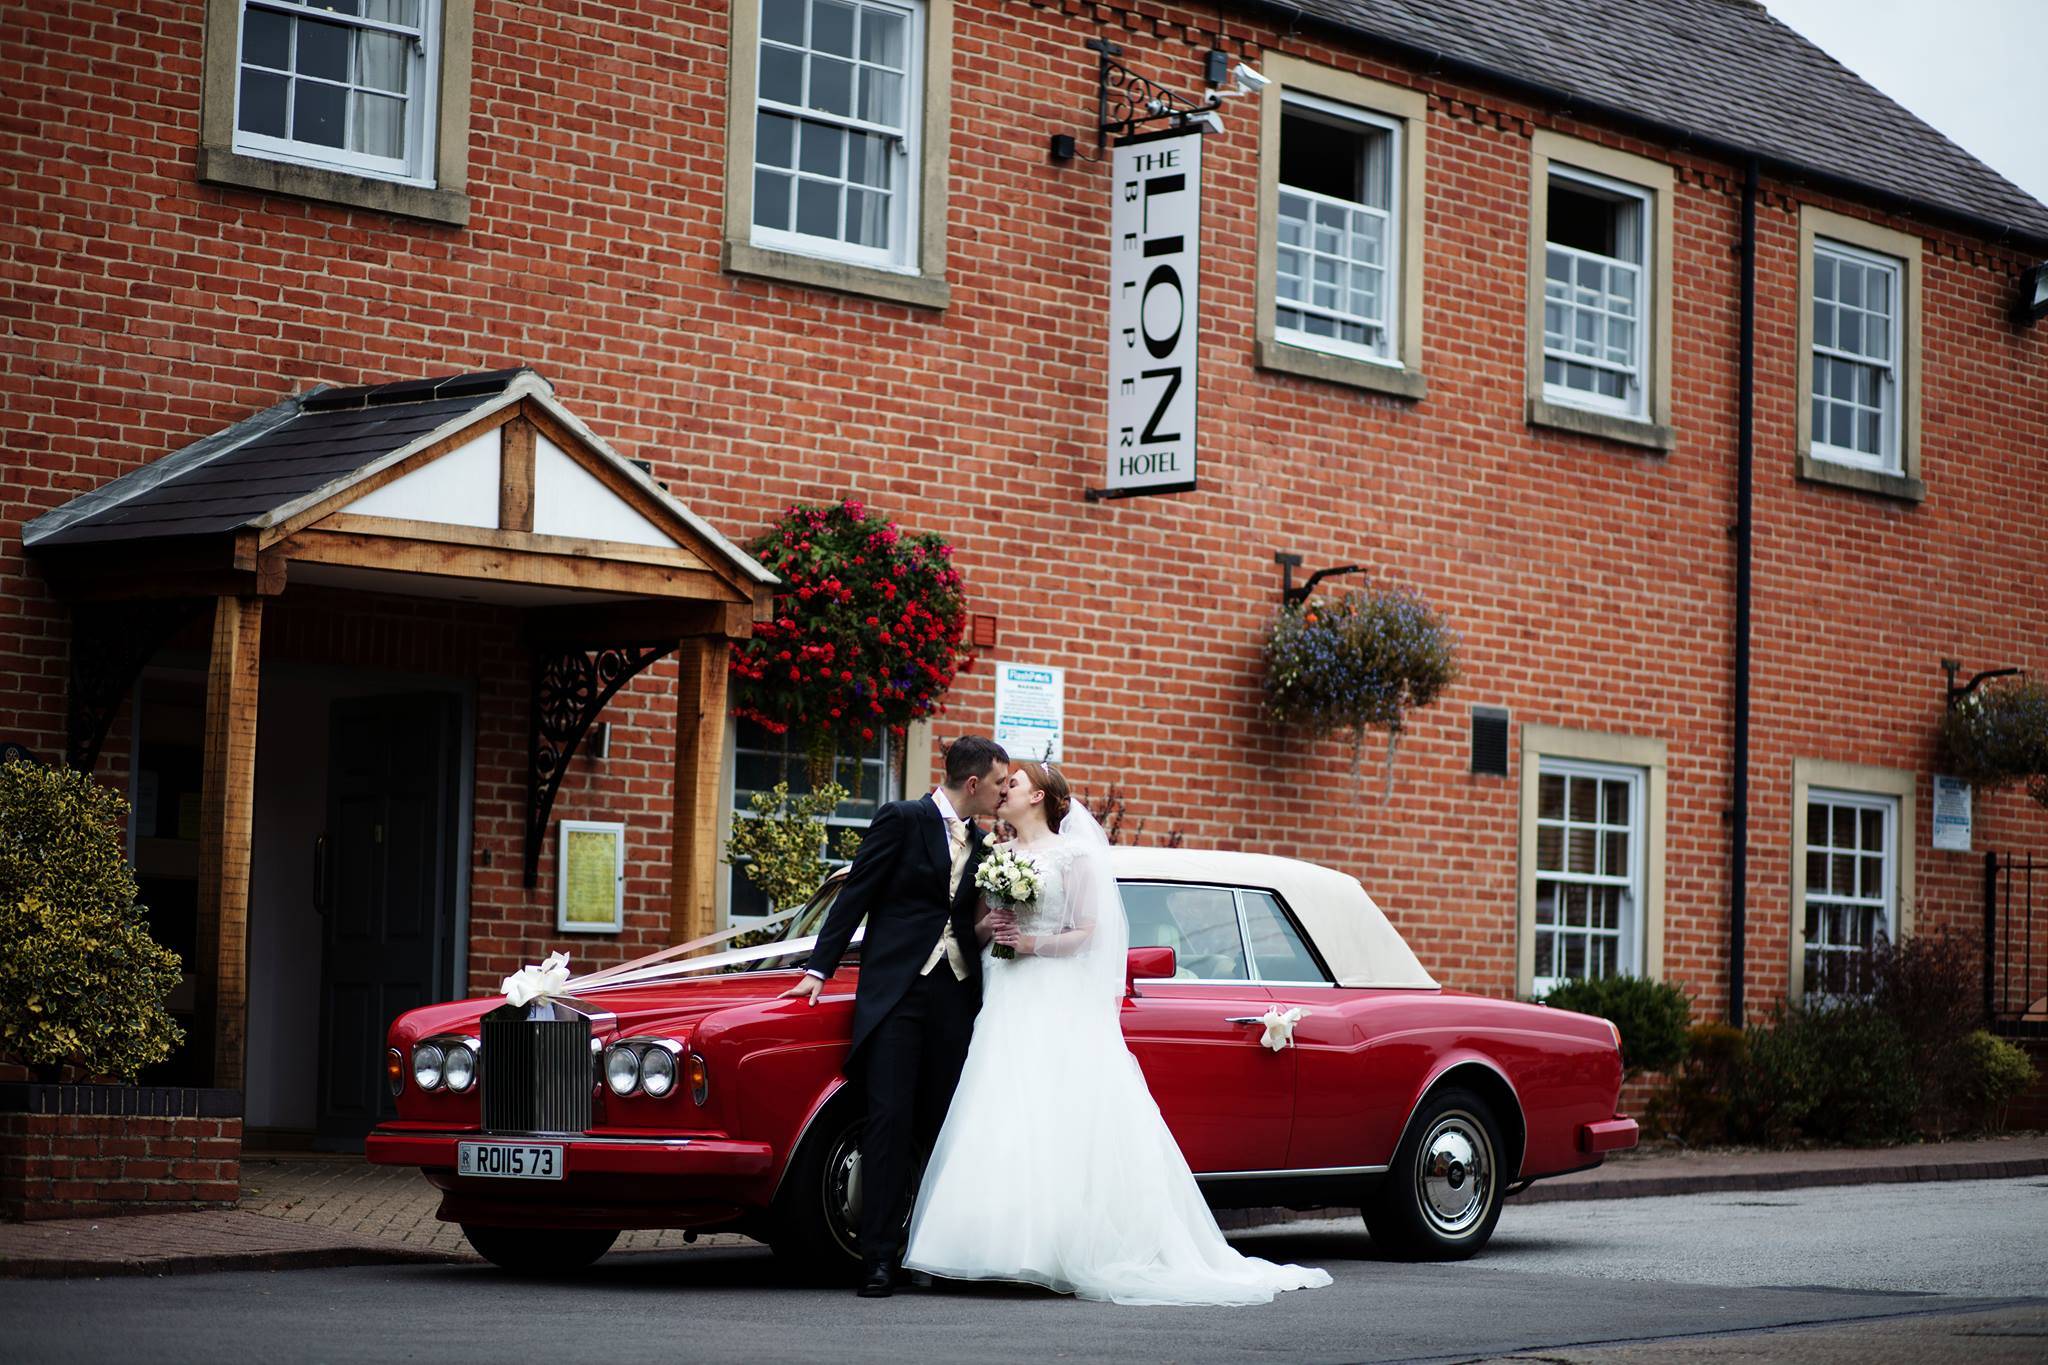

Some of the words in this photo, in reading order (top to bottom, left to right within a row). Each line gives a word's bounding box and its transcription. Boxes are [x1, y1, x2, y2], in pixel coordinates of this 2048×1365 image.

[1132, 149, 1181, 172] THE
[1120, 181, 1138, 448] BELPER
[1140, 173, 1186, 446] LION
[1120, 452, 1180, 476] HOTEL
[529, 1148, 553, 1175] 73
